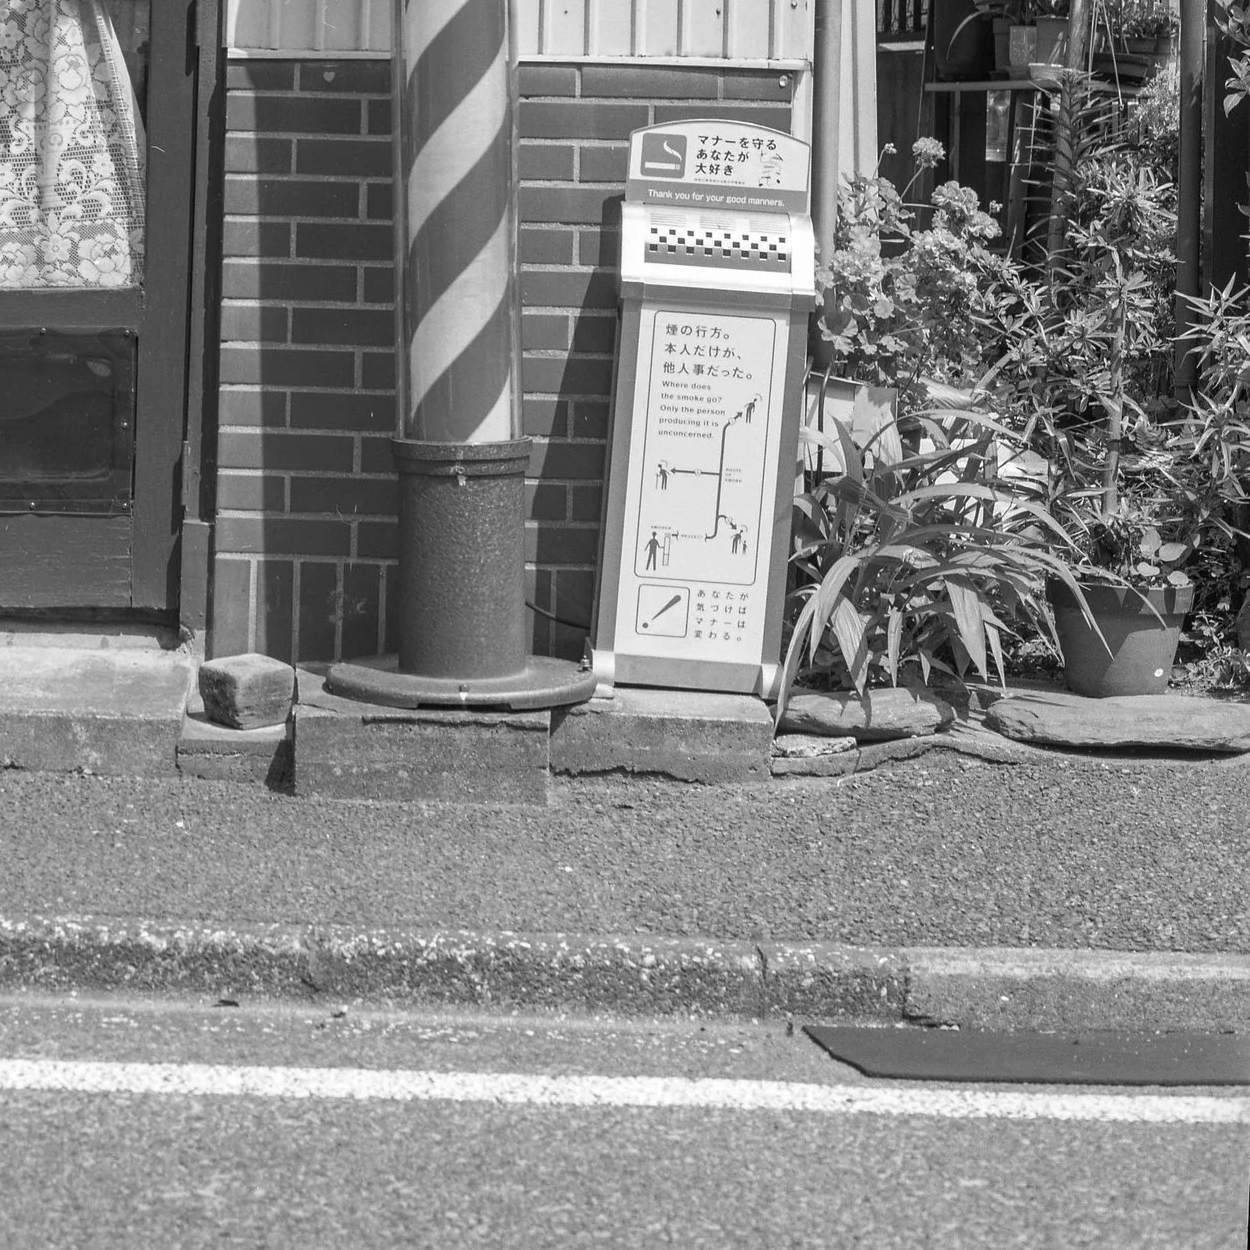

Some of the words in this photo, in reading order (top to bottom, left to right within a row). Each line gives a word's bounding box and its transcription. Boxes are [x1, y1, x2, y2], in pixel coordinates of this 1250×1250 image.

[698, 135, 777, 150] マナーを守る
[696, 149, 750, 163] あなたが
[695, 163, 734, 176] 大好き
[648, 189, 673, 199] Thank
[675, 192, 690, 201] you
[692, 192, 704, 201] for
[706, 195, 724, 203] your
[726, 195, 746, 205] good
[748, 197, 785, 207] manners.
[666, 323, 730, 340] 煙の行方。
[664, 342, 741, 360] 本人だけが、
[663, 361, 752, 380] 他人事だった。
[662, 380, 689, 389] Where
[691, 382, 711, 390] does
[661, 392, 674, 400] the
[676, 394, 705, 402] smoke
[706, 396, 723, 404] go?
[660, 404, 679, 413] Only
[681, 406, 695, 414] the
[696, 407, 726, 416] person
[659, 417, 701, 427] producing
[658, 429, 714, 439] unconcerned.
[697, 589, 749, 600] あなたが
[696, 603, 747, 615] 気づけば
[695, 617, 746, 629] マナーは
[694, 629, 742, 642] 変わる。
